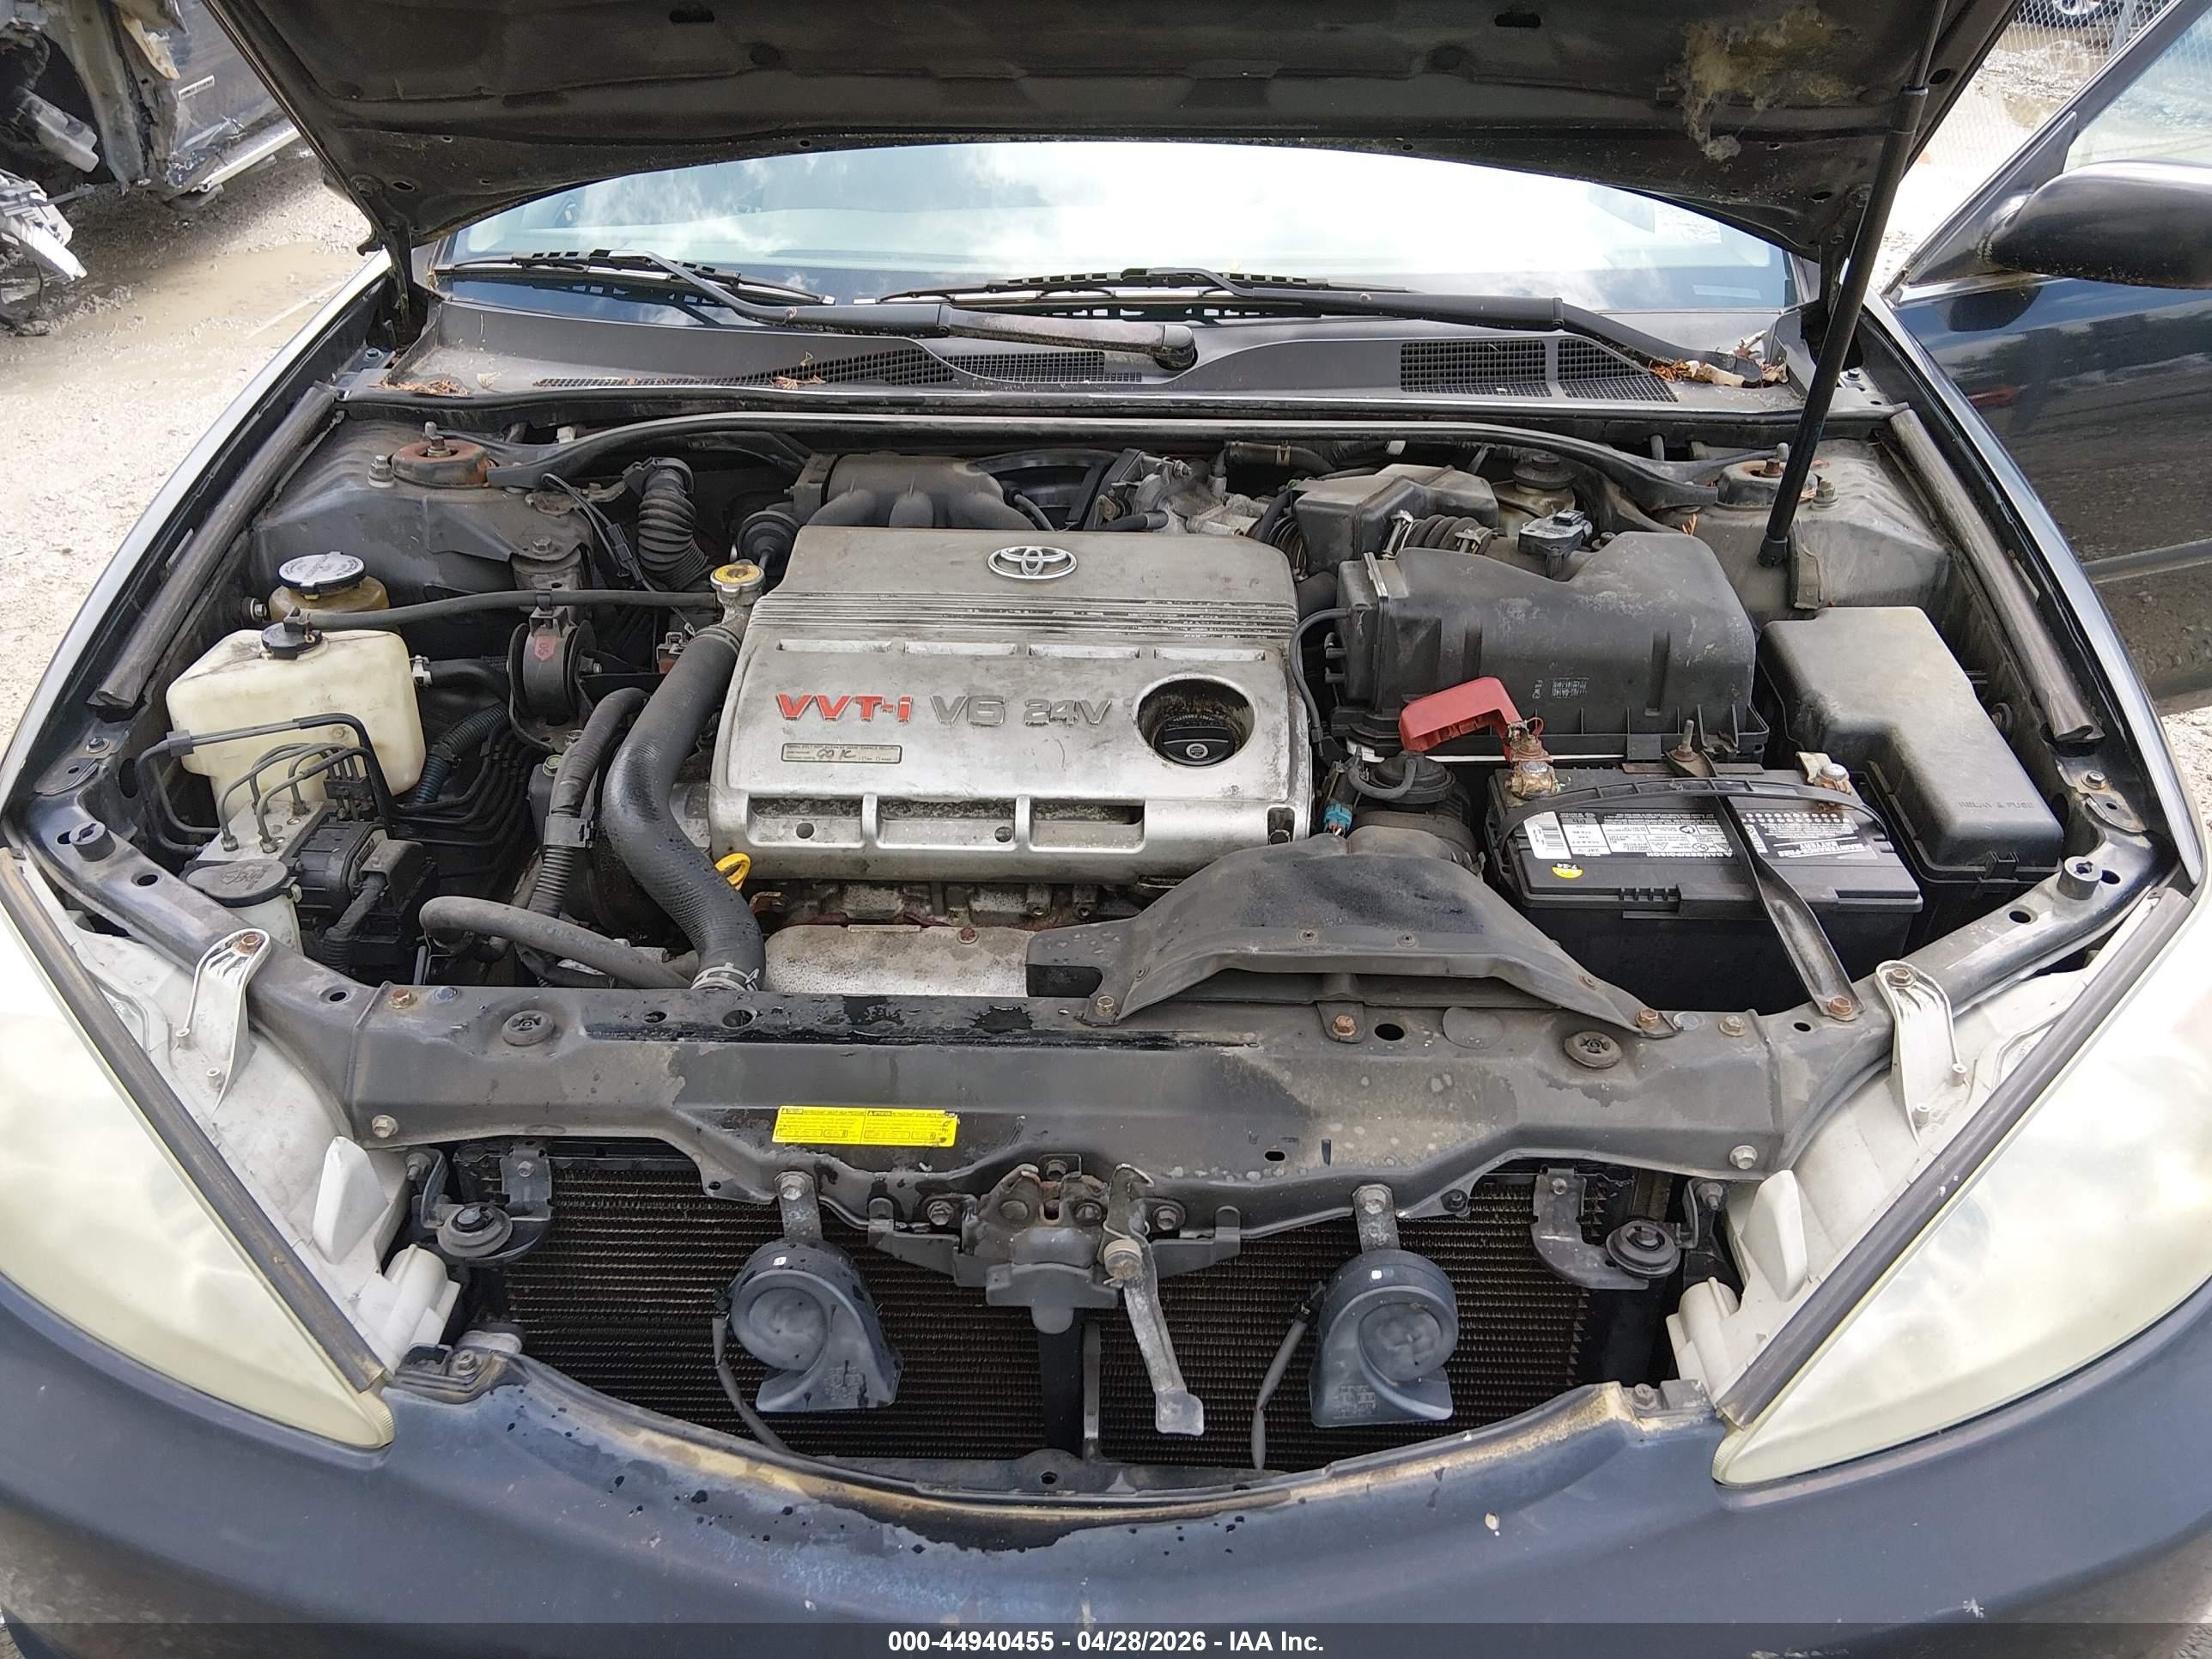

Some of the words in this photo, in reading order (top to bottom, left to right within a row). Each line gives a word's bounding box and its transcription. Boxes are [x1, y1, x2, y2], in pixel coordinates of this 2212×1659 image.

[776, 693, 913, 723] VVT-i
[930, 694, 1006, 726] V6
[1024, 698, 1112, 727] 24V
